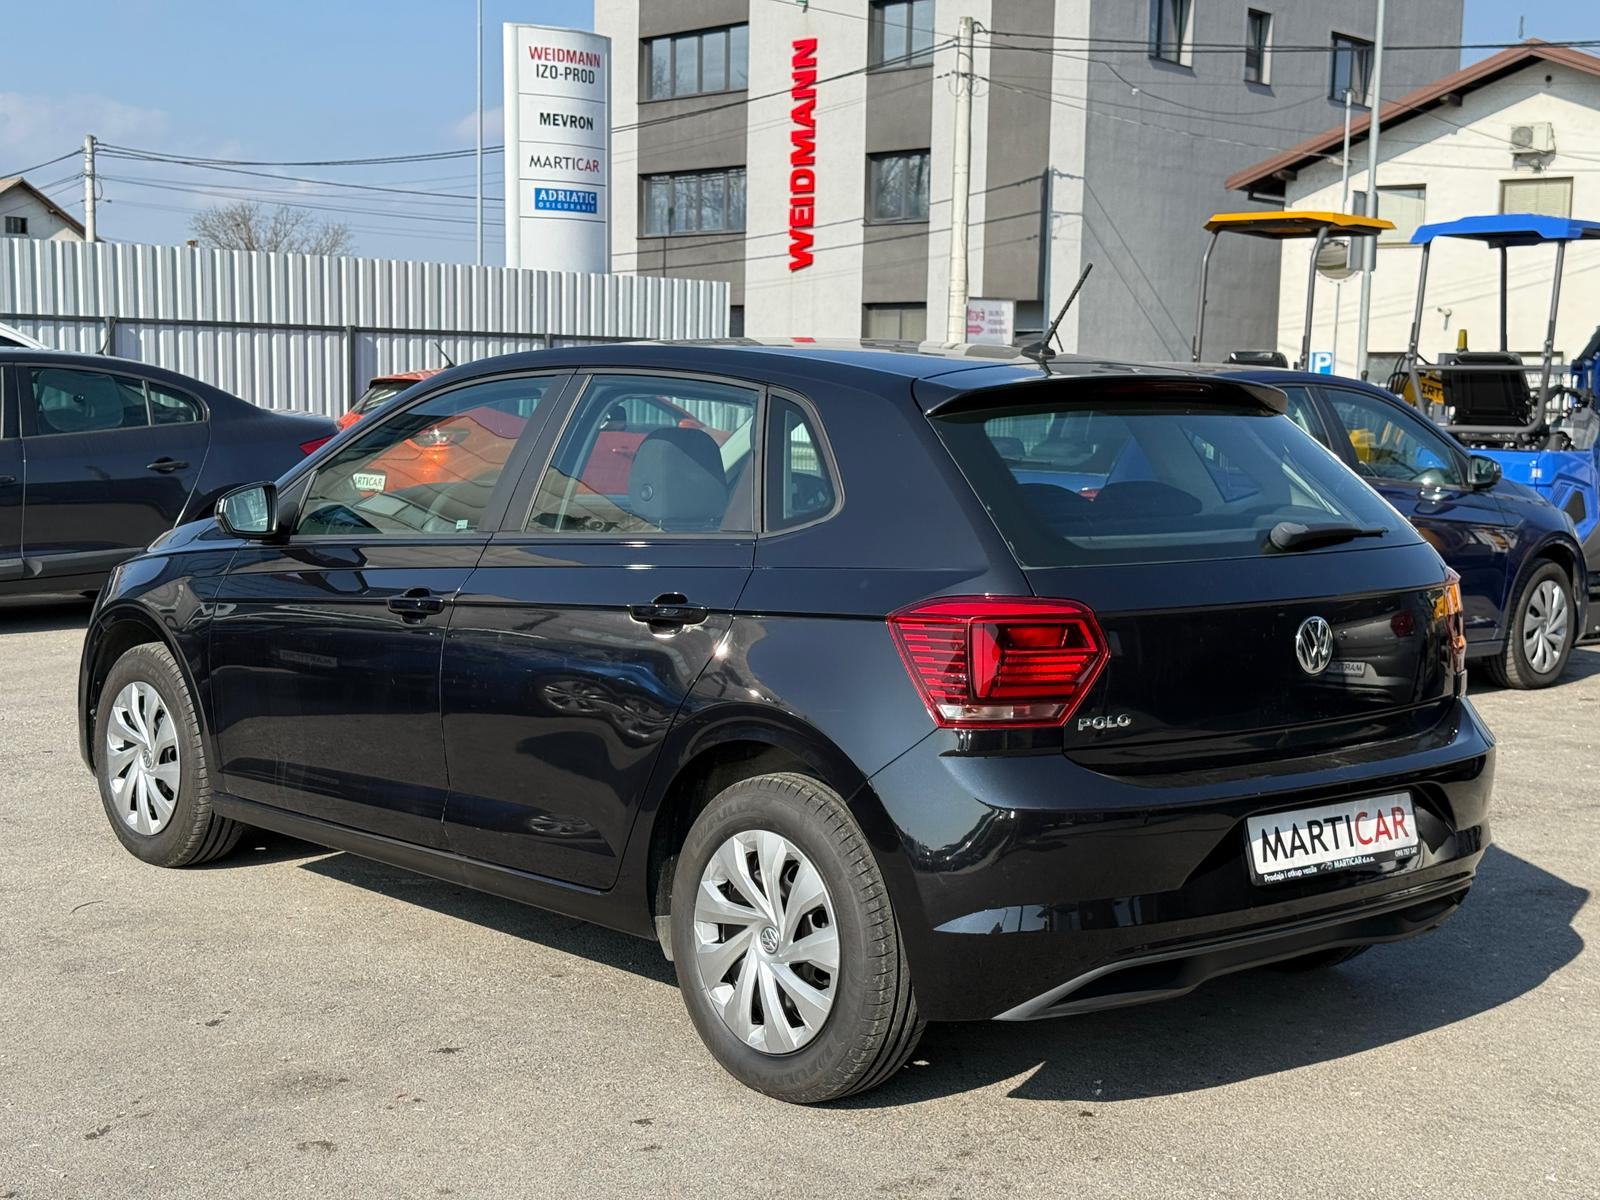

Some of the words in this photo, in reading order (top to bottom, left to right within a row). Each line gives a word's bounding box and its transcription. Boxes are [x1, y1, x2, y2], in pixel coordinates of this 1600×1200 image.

[529, 46, 600, 68] WEIDMANN
[536, 64, 595, 84] IZO-PROD
[539, 112, 594, 131] MEVRON
[529, 155, 600, 173] MARTICAR
[788, 38, 818, 272] WEIDMANN
[539, 189, 595, 205] ADRIATIC
[1315, 353, 1331, 374] P
[1078, 714, 1131, 731] POLO
[1261, 806, 1409, 863] MARTICAR
[1334, 856, 1362, 868] MARTICAR
